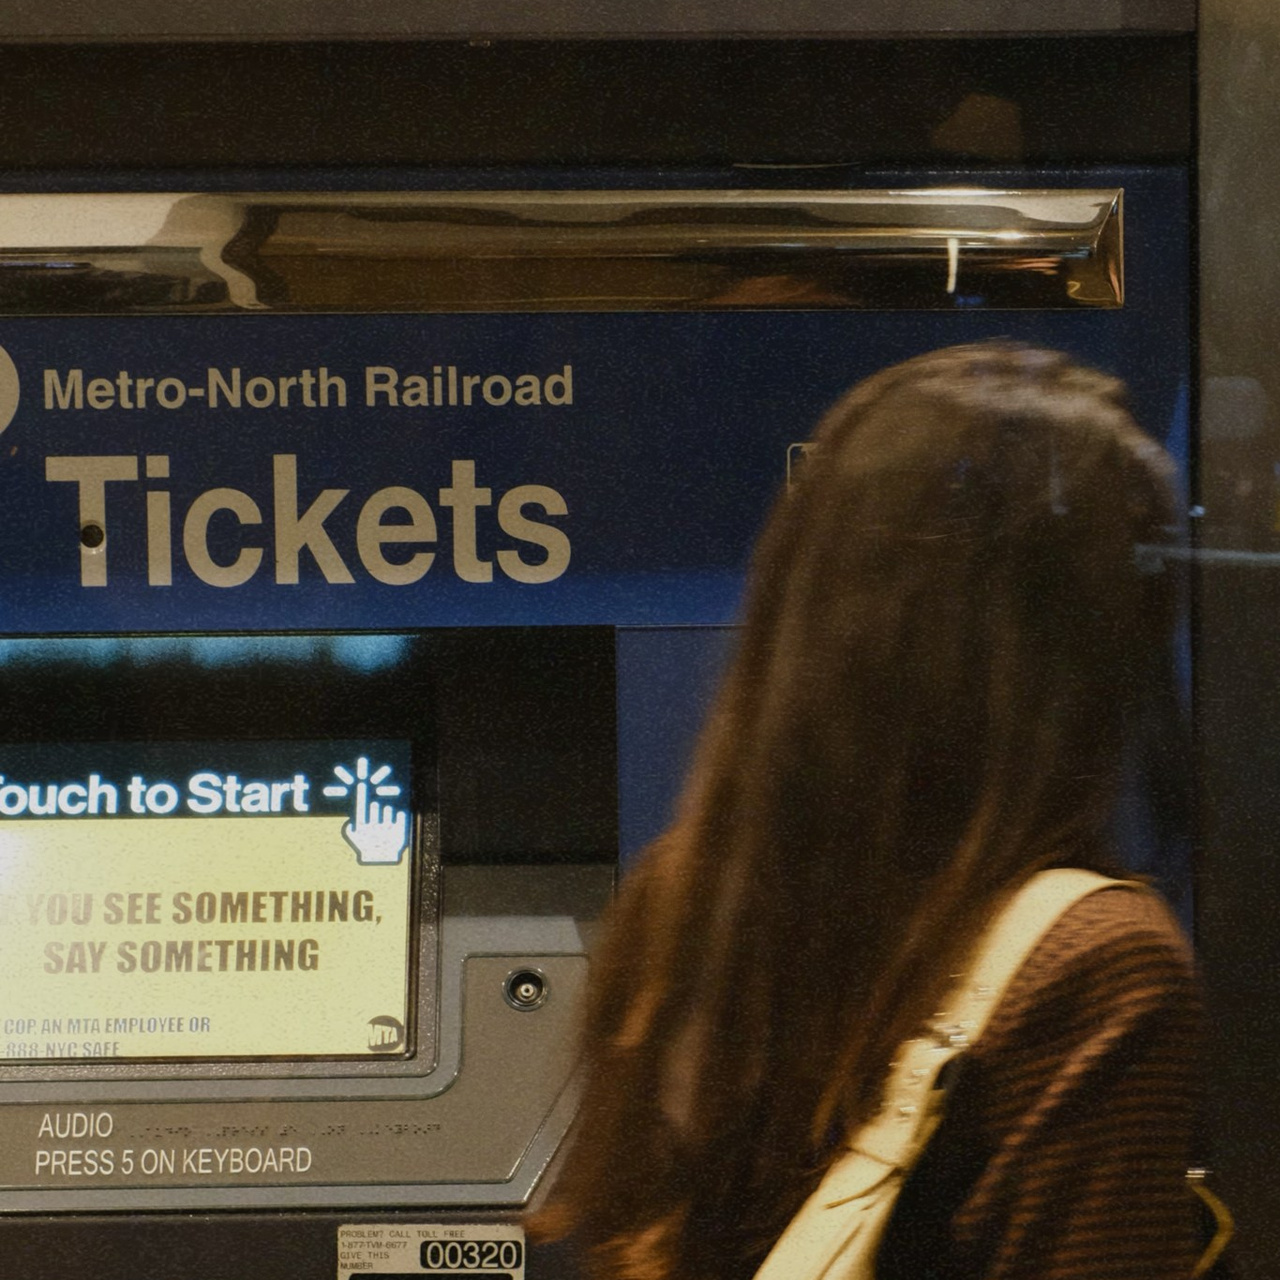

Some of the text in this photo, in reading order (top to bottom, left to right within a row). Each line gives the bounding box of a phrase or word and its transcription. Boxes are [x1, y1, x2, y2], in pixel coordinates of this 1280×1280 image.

[42, 364, 574, 410] Metro-North Railroad
[45, 452, 571, 589] Tickets
[128, 776, 178, 814] to
[187, 773, 310, 813] Start
[25, 893, 93, 926] YOU
[103, 892, 162, 924] SEE
[172, 890, 382, 925] SOMETHING,
[43, 939, 320, 974] SAY SOMETHING
[41, 1019, 62, 1034] AN
[67, 1019, 100, 1033] MTA
[105, 1017, 184, 1033] EMPLOYEE
[189, 1017, 210, 1033] OR
[38, 1112, 113, 1138] AUDIO
[36, 1148, 311, 1175] PRESS 5 ON KEYBOARD
[340, 1230, 465, 1238] PROBLEM? CALL TOLL FREE
[340, 1262, 373, 1270] NUMBER
[427, 1242, 517, 1268] 00320
